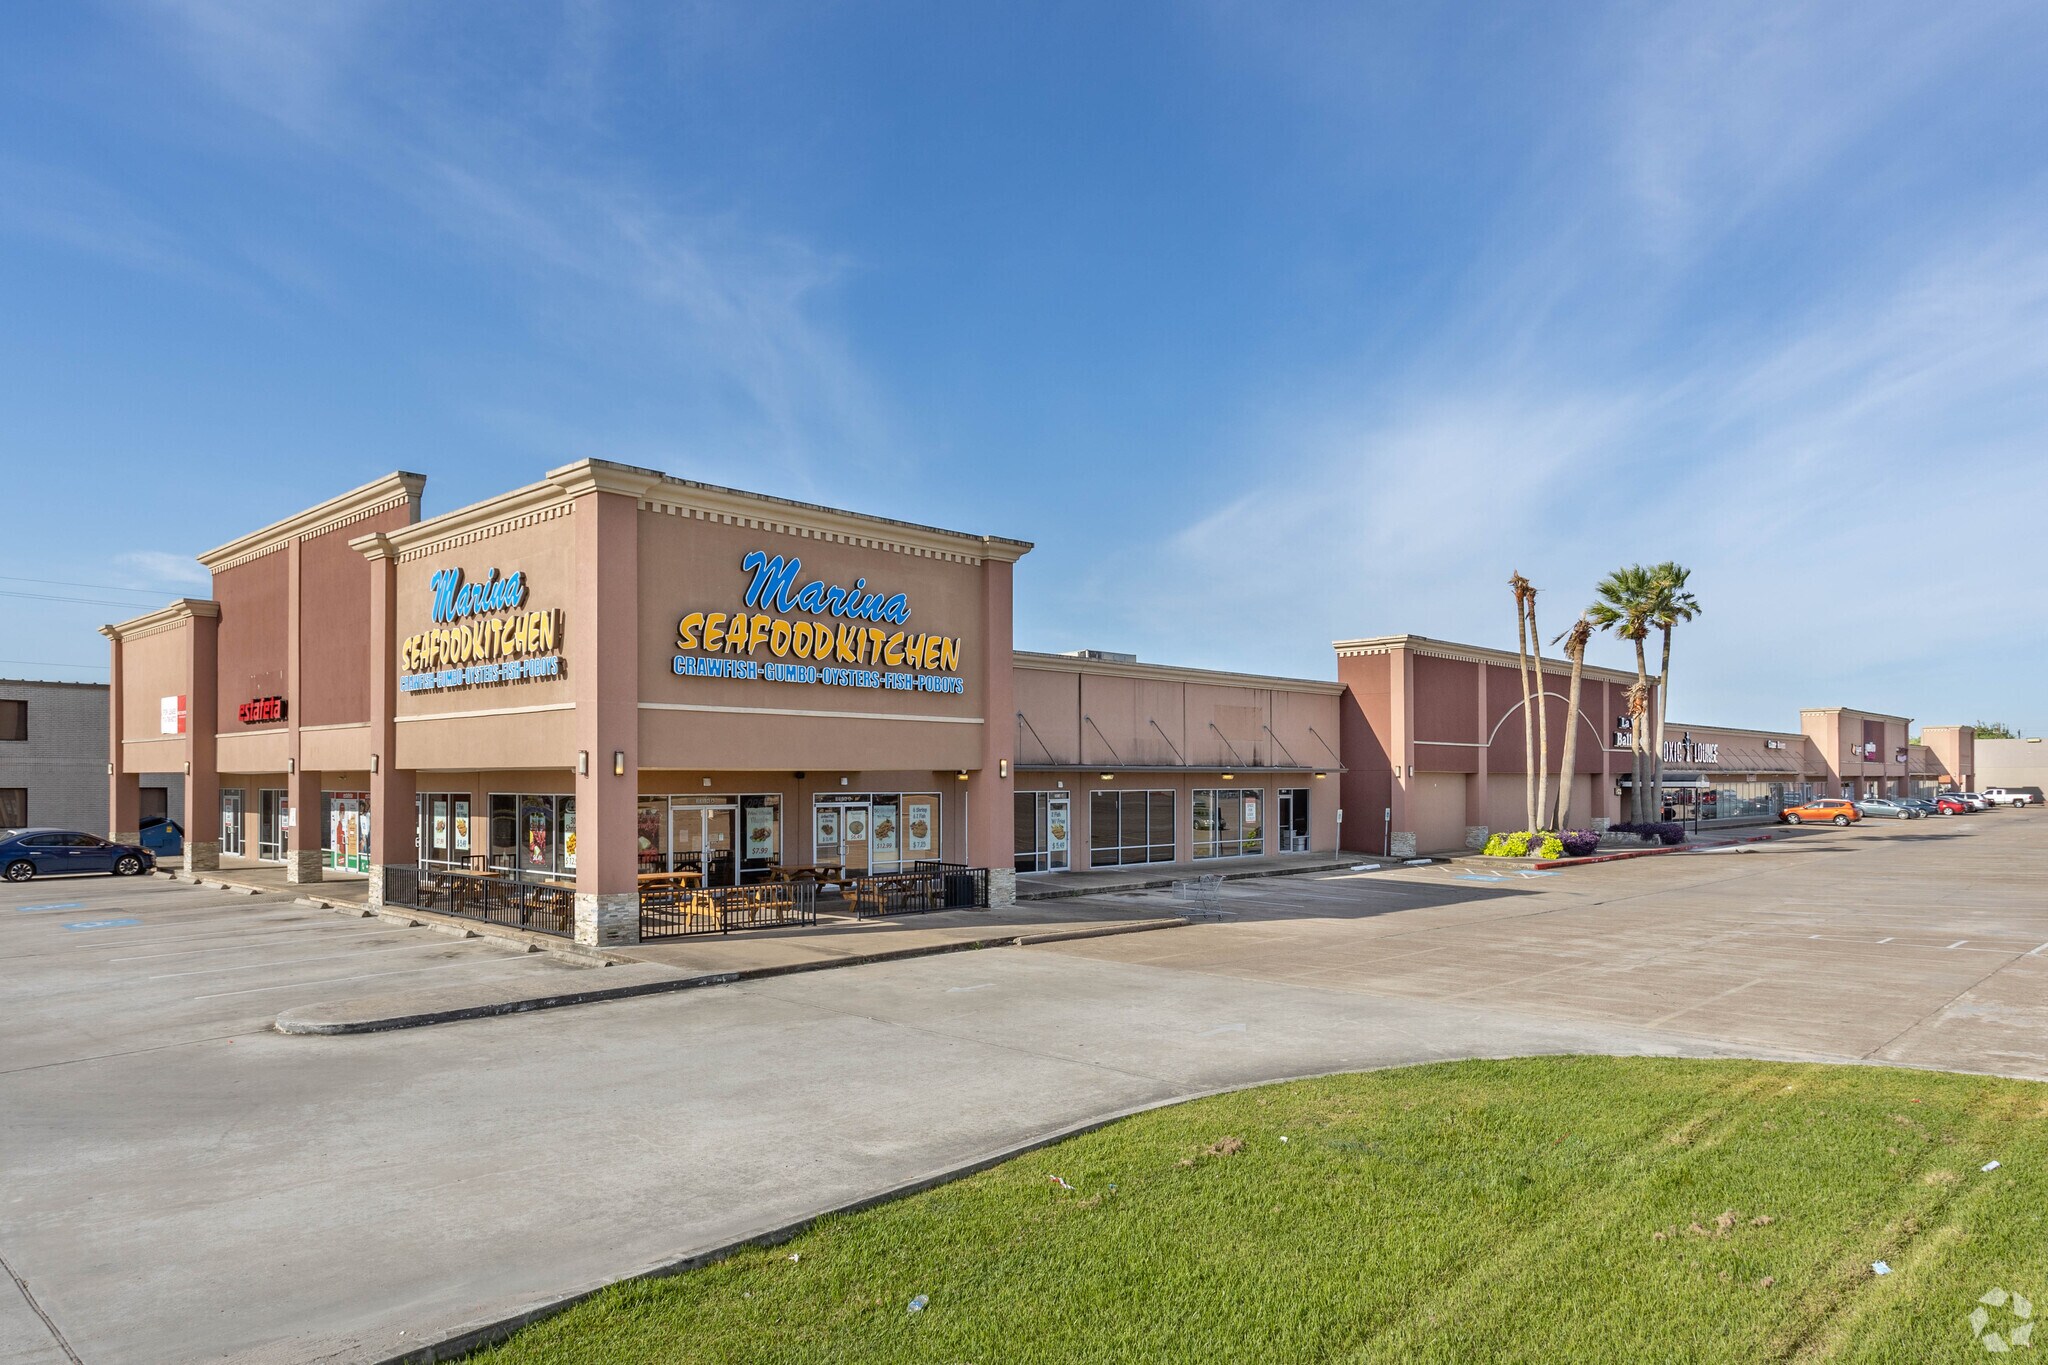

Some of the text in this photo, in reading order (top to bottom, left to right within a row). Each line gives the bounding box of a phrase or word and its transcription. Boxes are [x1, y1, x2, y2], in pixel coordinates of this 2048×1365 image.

[430, 566, 524, 623] Marina
[742, 551, 911, 625] Marina
[401, 607, 556, 671] SEAFOODKITCHEN
[676, 612, 961, 672] SEAFOODKITCHEN
[238, 697, 281, 722] estafeta
[1663, 741, 1718, 764] OXIC LOUNGE
[752, 847, 768, 855] $7.99
